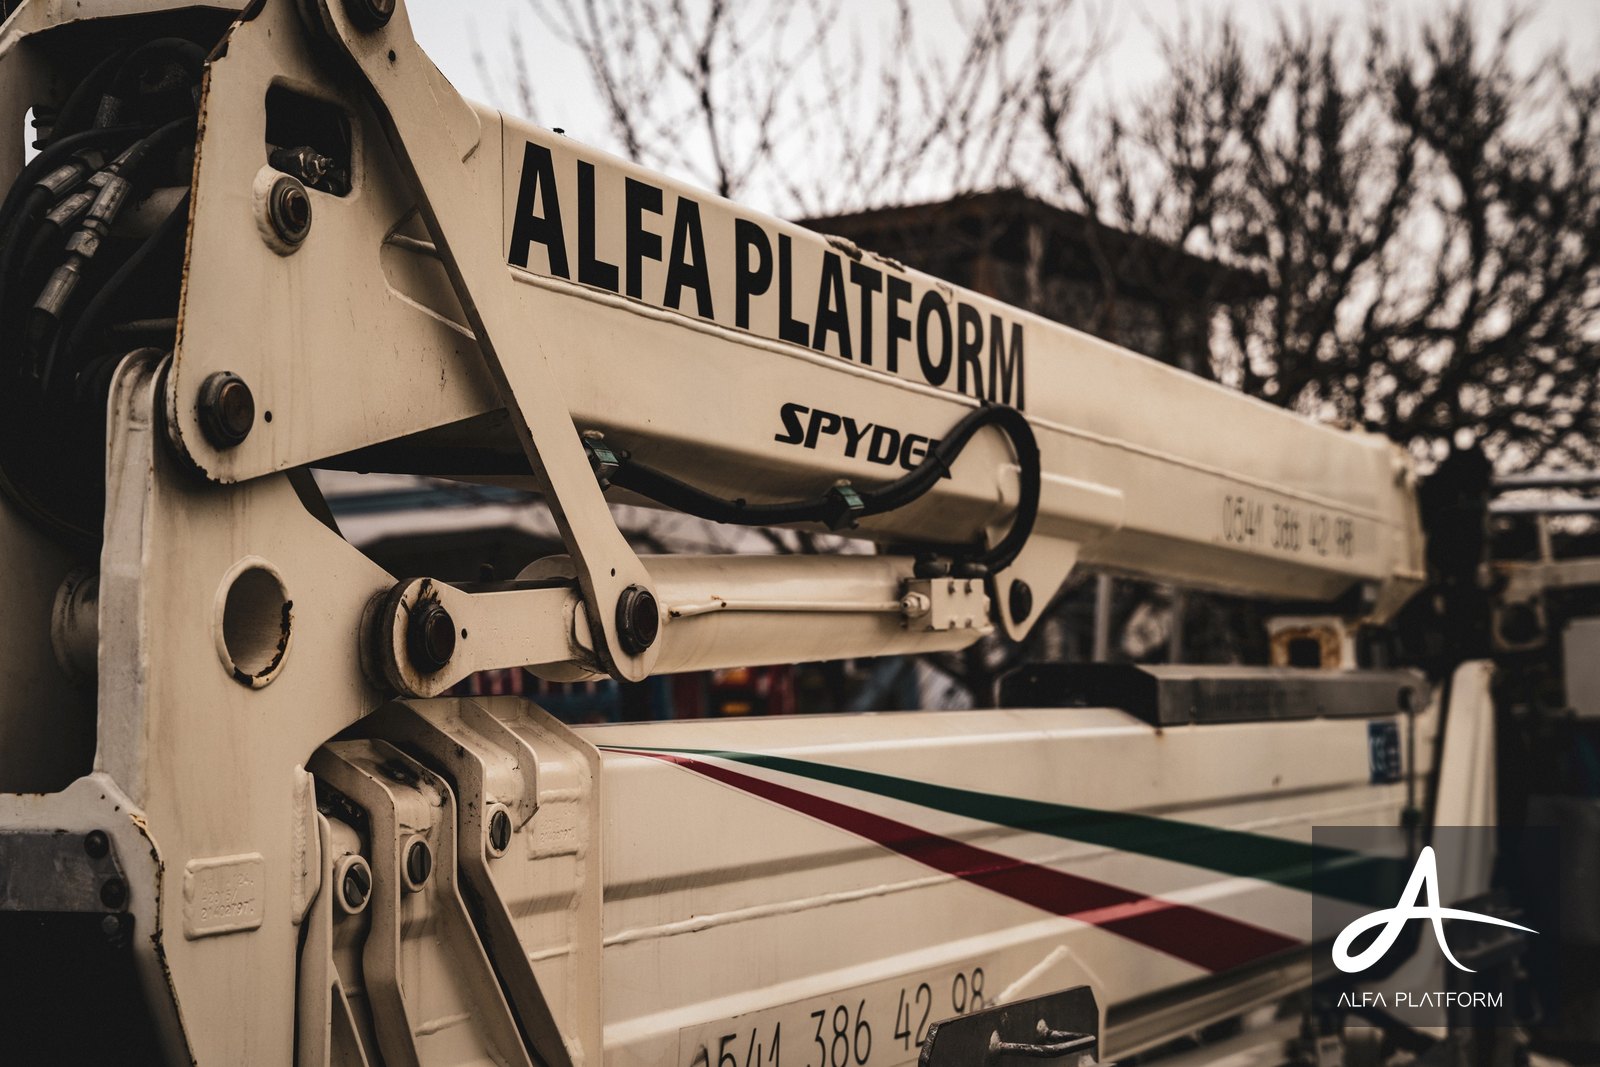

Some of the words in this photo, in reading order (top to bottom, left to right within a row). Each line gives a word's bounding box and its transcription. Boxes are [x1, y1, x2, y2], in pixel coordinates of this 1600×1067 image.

[508, 140, 715, 320] ALFA
[735, 217, 1025, 412] PLATFORM
[806, 1000, 872, 1067] 386
[894, 982, 932, 1052] 42
